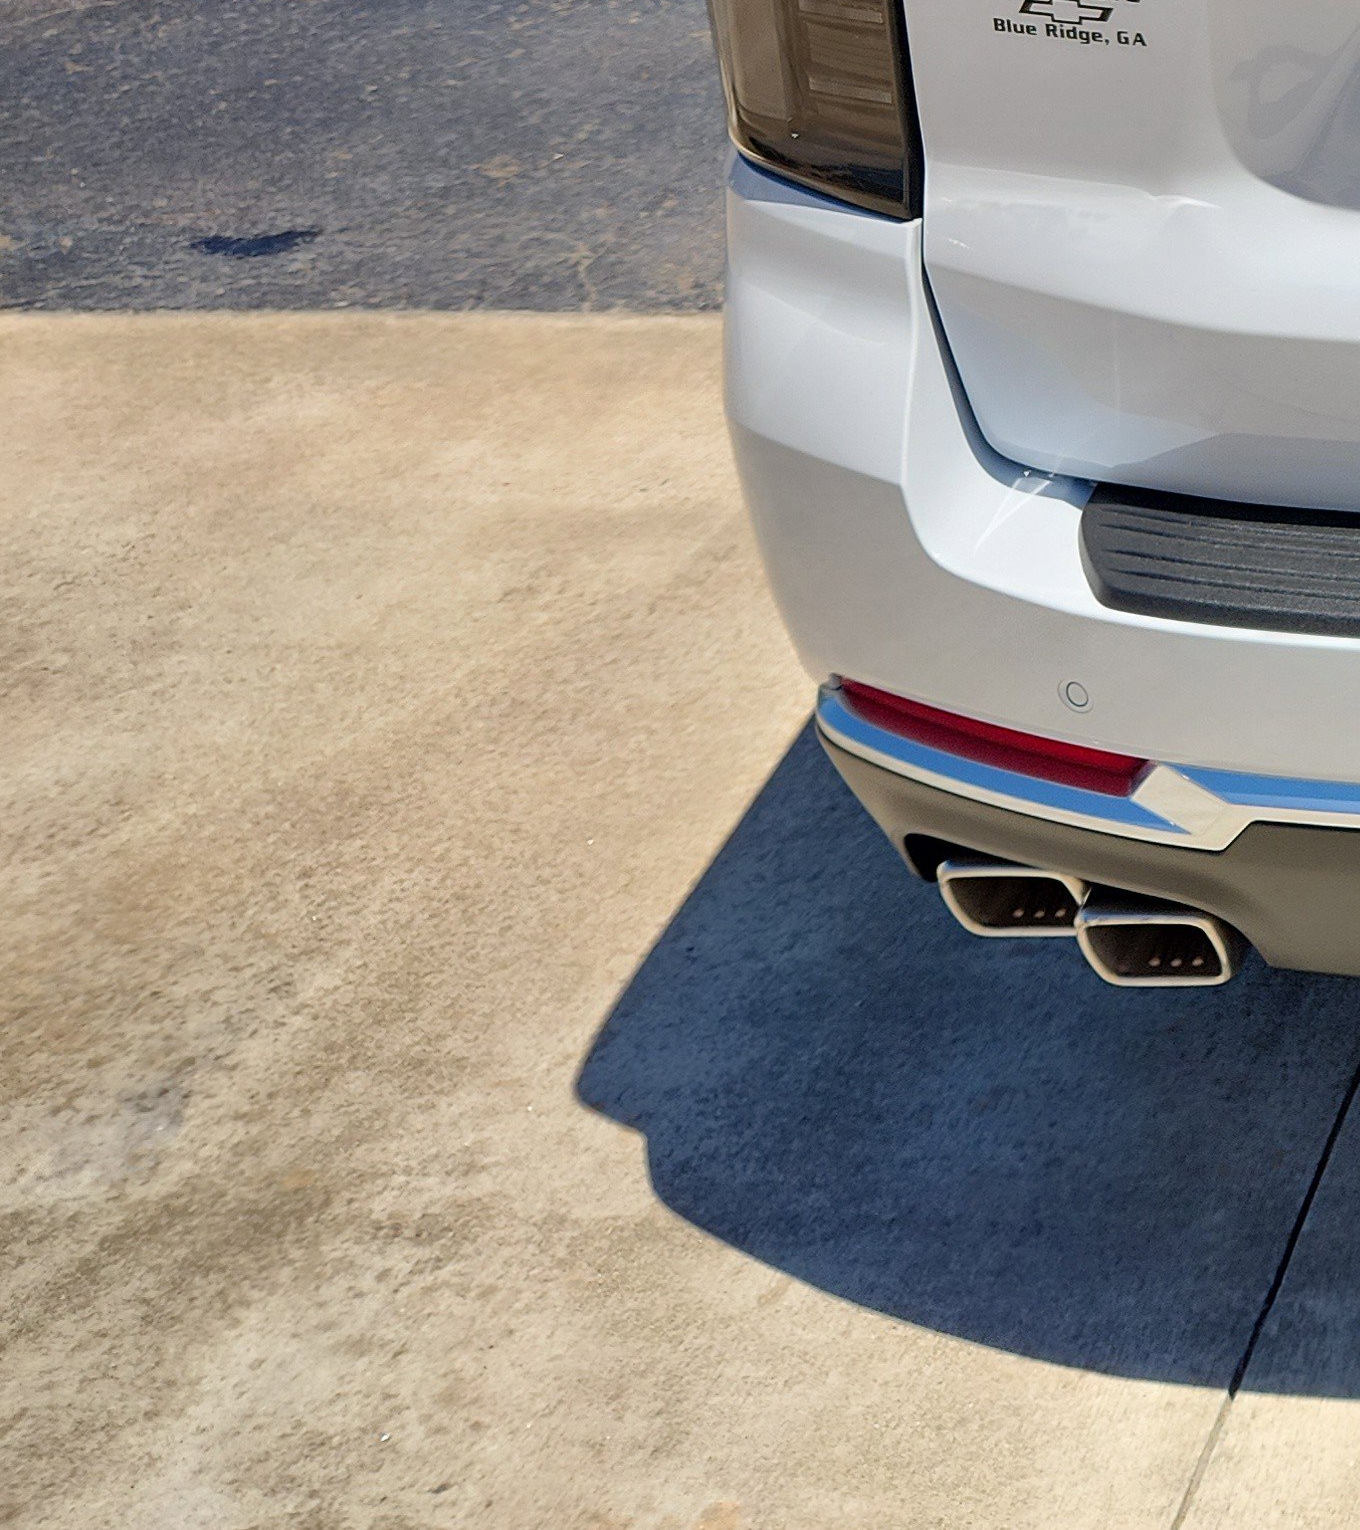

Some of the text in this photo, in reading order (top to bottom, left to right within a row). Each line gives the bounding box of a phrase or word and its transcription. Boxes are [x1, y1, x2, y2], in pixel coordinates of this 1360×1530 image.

[993, 17, 1148, 47] Blue Ridge, GA
